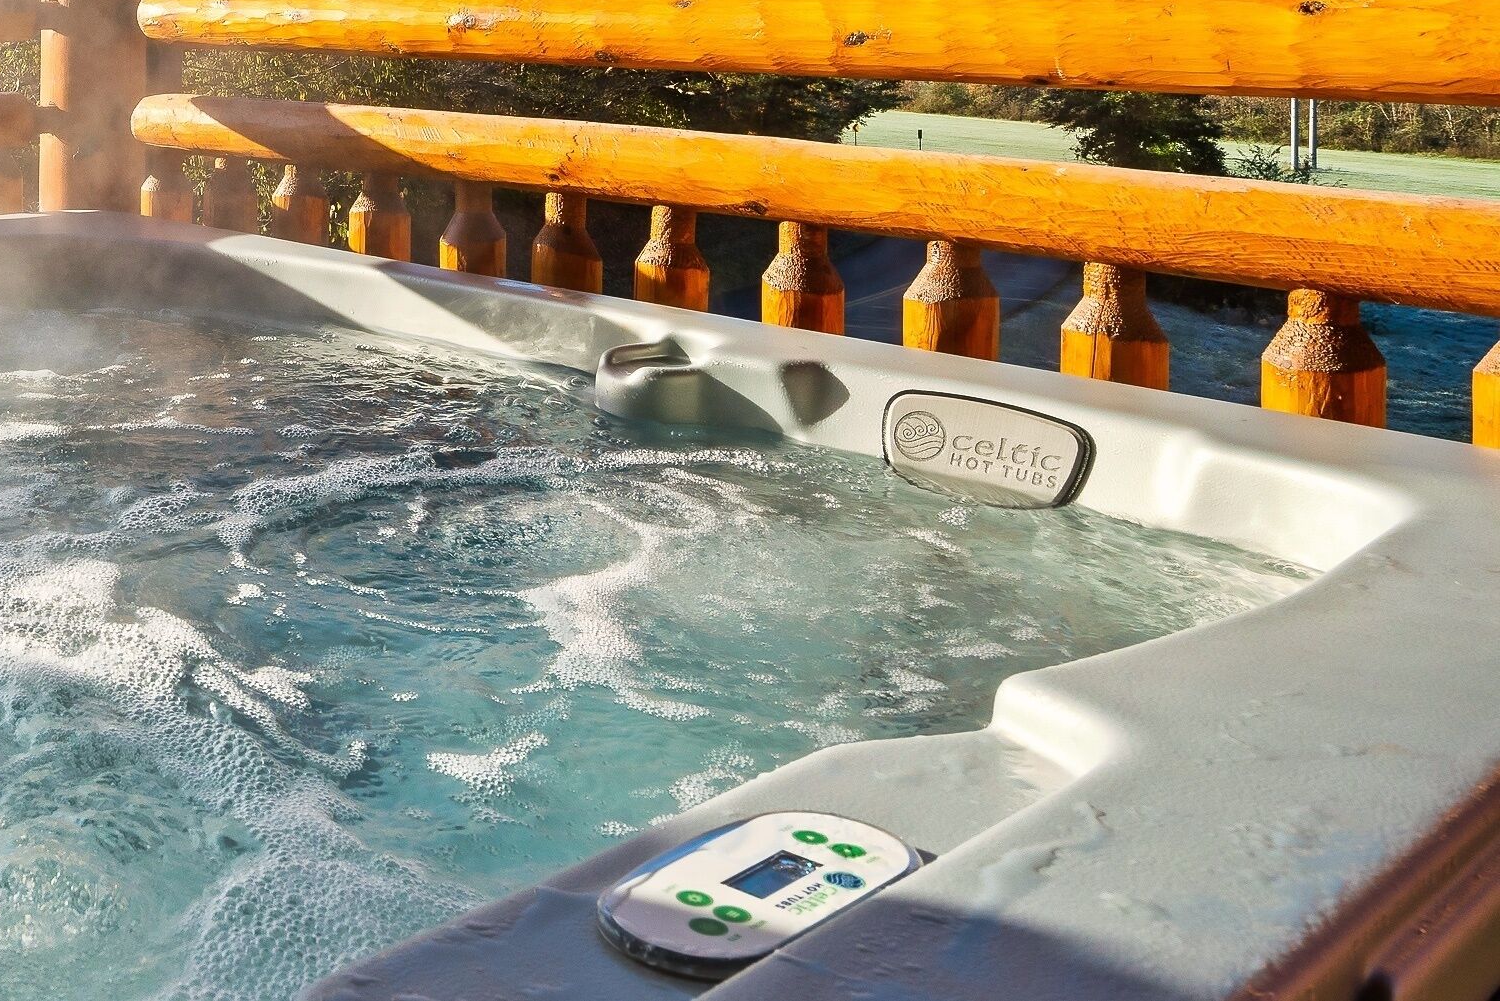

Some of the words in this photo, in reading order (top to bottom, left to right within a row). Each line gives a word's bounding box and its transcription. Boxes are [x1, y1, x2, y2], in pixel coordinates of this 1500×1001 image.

[950, 453, 993, 473] HOT
[1002, 465, 1057, 488] TUBS
[802, 882, 824, 895] HOT
[775, 894, 804, 909] TUBS
